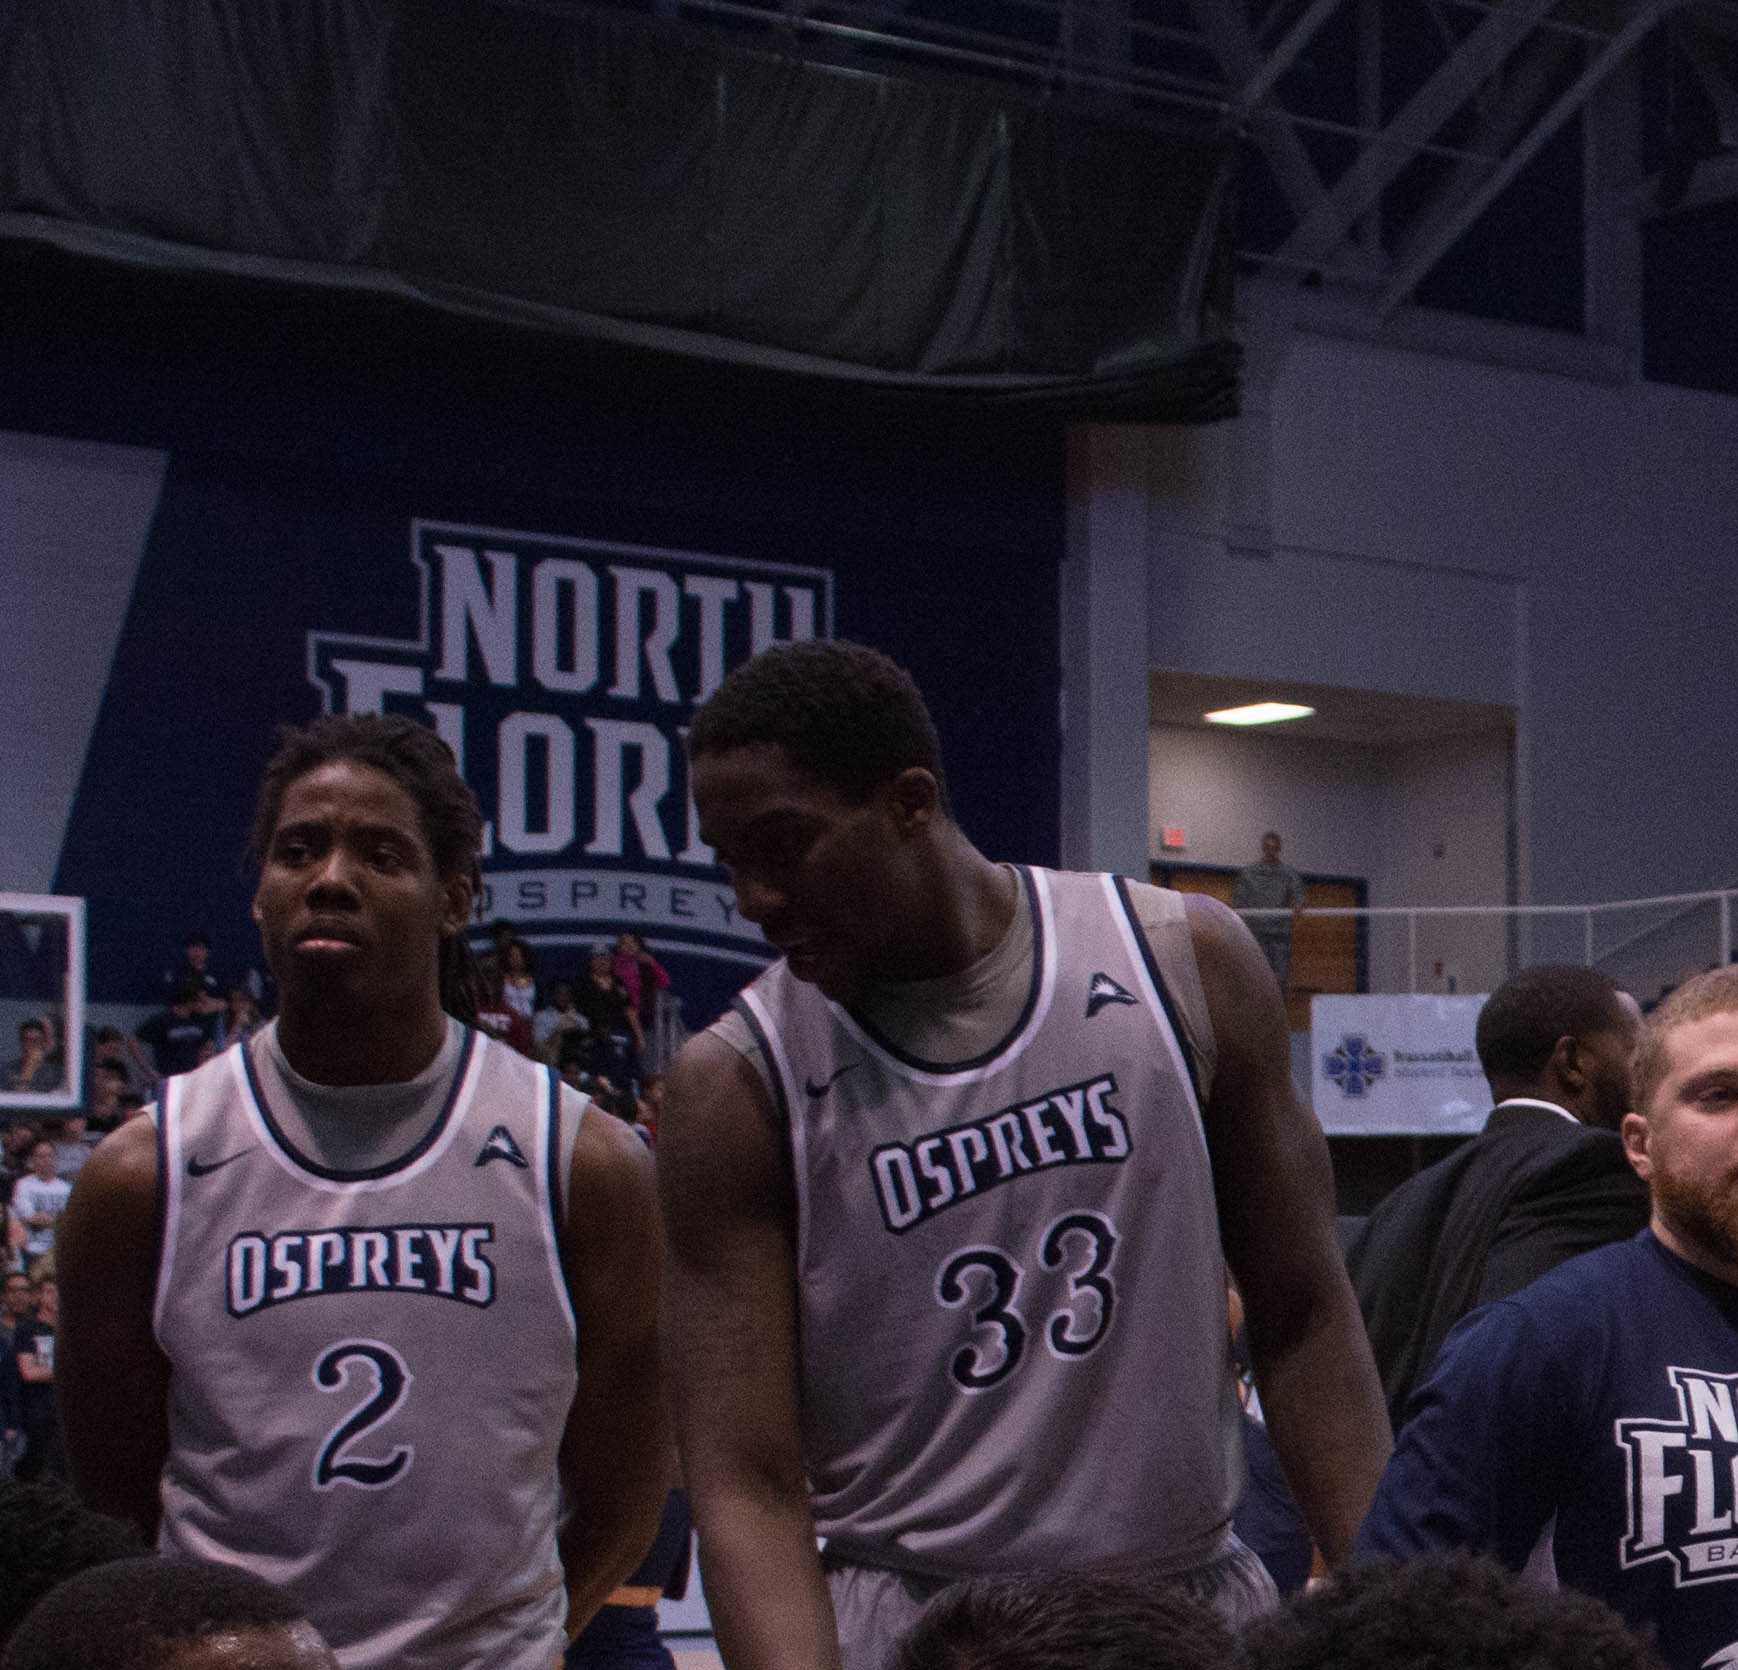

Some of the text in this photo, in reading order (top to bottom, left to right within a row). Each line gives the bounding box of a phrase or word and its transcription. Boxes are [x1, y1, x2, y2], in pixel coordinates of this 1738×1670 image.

[871, 1076, 1131, 1233] OSPREYS
[227, 1226, 494, 1316] OSPREYS
[937, 1211, 1119, 1390] 33
[314, 1340, 412, 1488] 2
